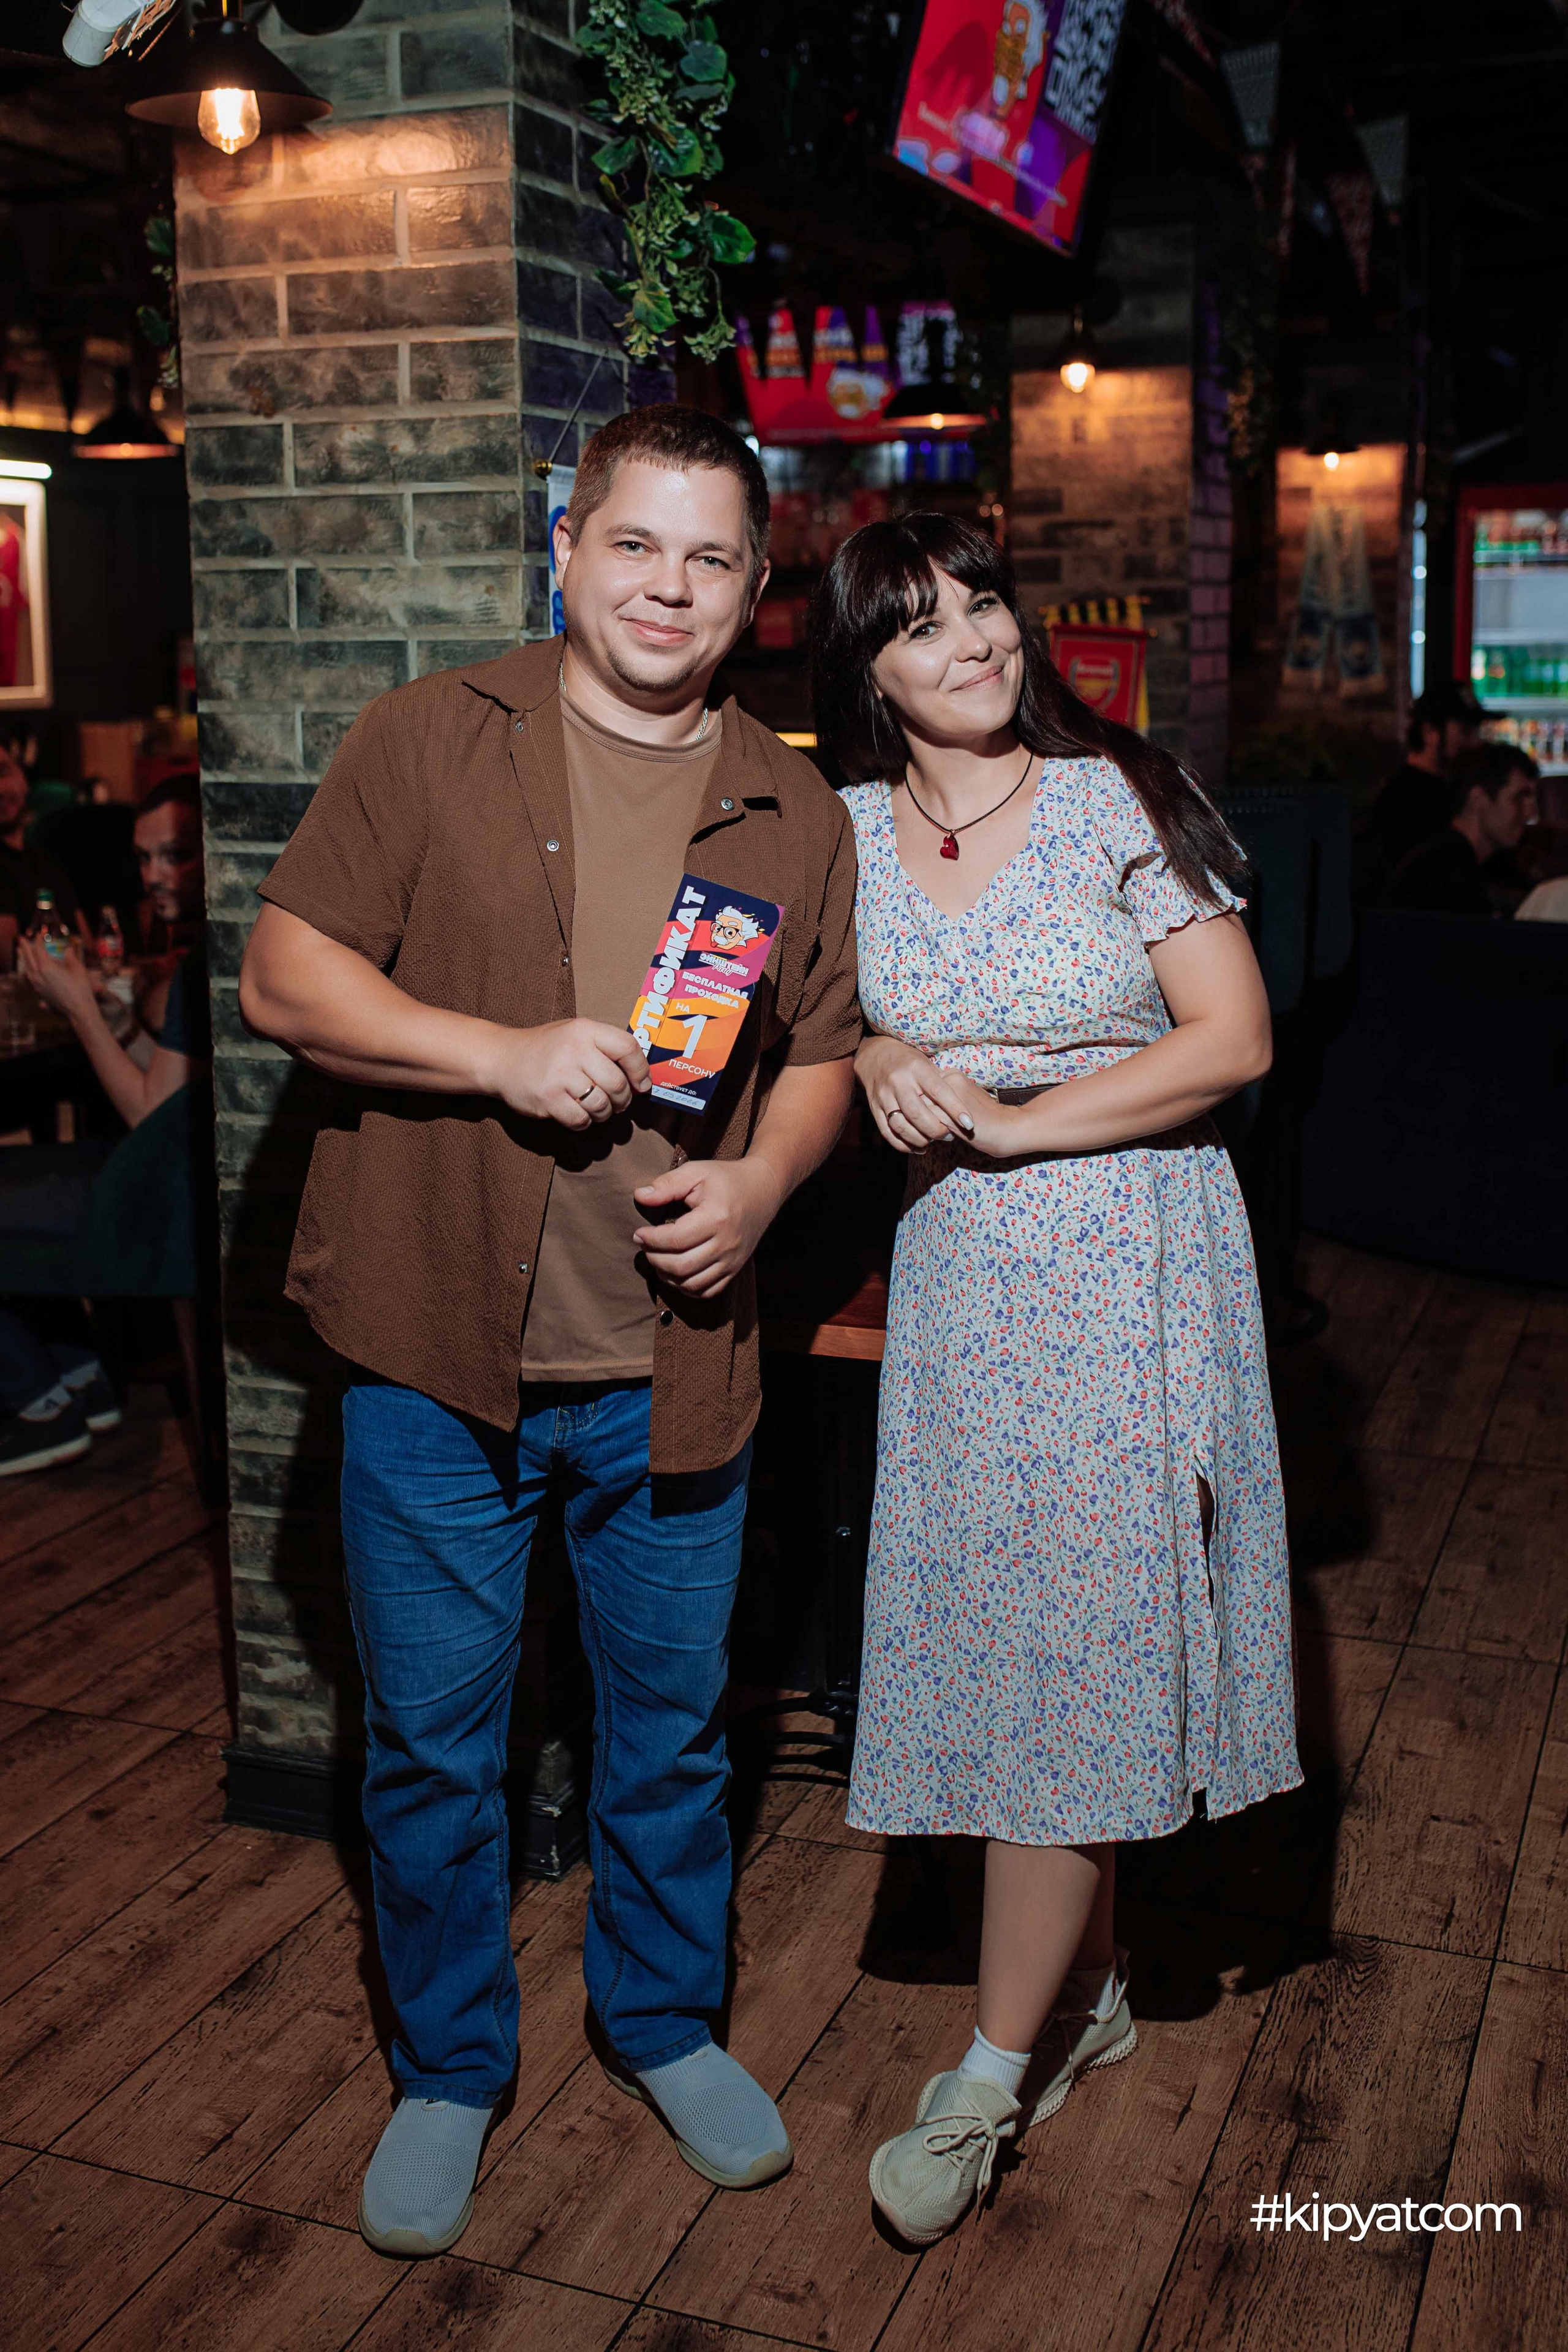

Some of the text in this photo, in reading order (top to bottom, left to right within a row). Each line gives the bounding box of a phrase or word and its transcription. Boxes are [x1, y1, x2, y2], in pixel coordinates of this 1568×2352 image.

[633, 885, 706, 1058] РТИФИКАТ
[682, 971, 748, 1000] БЕСПЛАТНАЯ
[684, 984, 739, 1009] ПРОХОДКА
[676, 1002, 690, 1014] НА
[682, 1014, 708, 1059] 1
[668, 1058, 715, 1079] ПЕРСОНУ
[660, 1081, 688, 1093] ДЕЙСТВУЕТ
